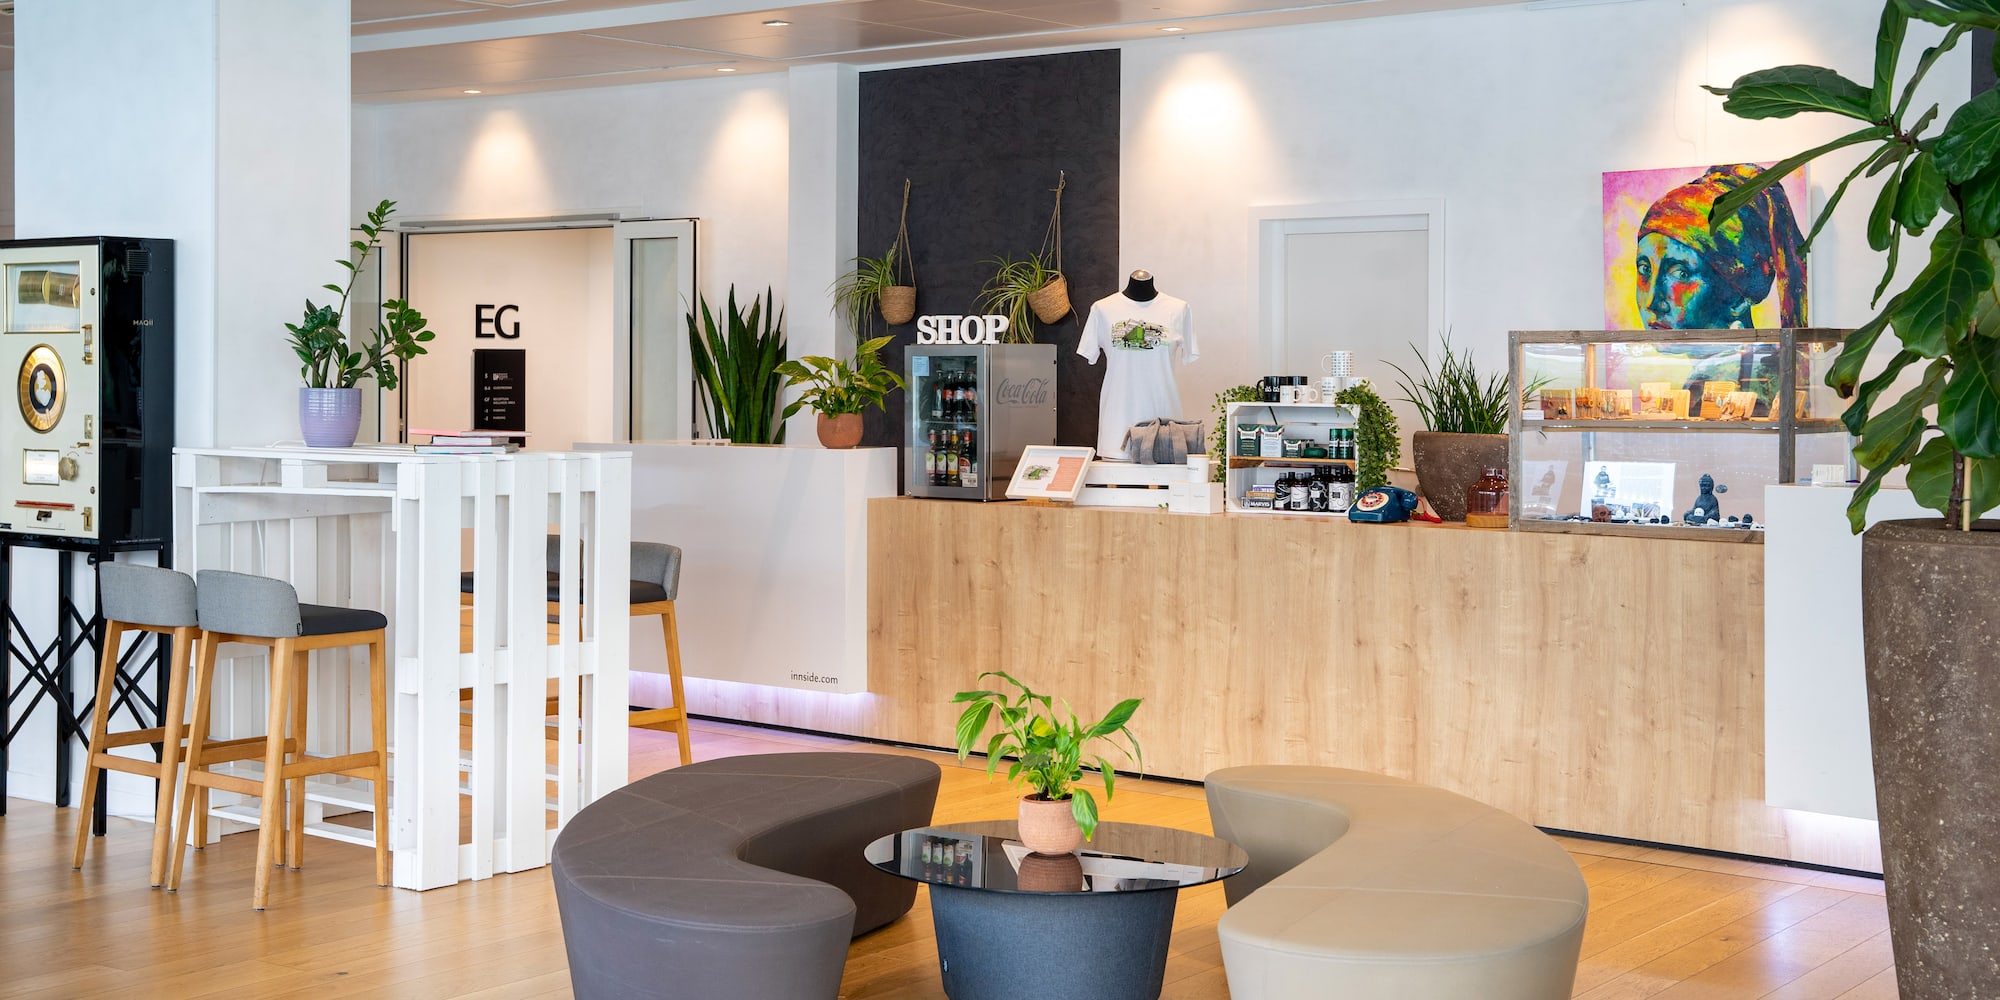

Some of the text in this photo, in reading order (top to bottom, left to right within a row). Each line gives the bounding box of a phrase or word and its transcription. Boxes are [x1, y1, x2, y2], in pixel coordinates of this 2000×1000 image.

[475, 304, 520, 339] EG
[917, 315, 1009, 344] SHOP
[790, 670, 839, 684] innside.com
